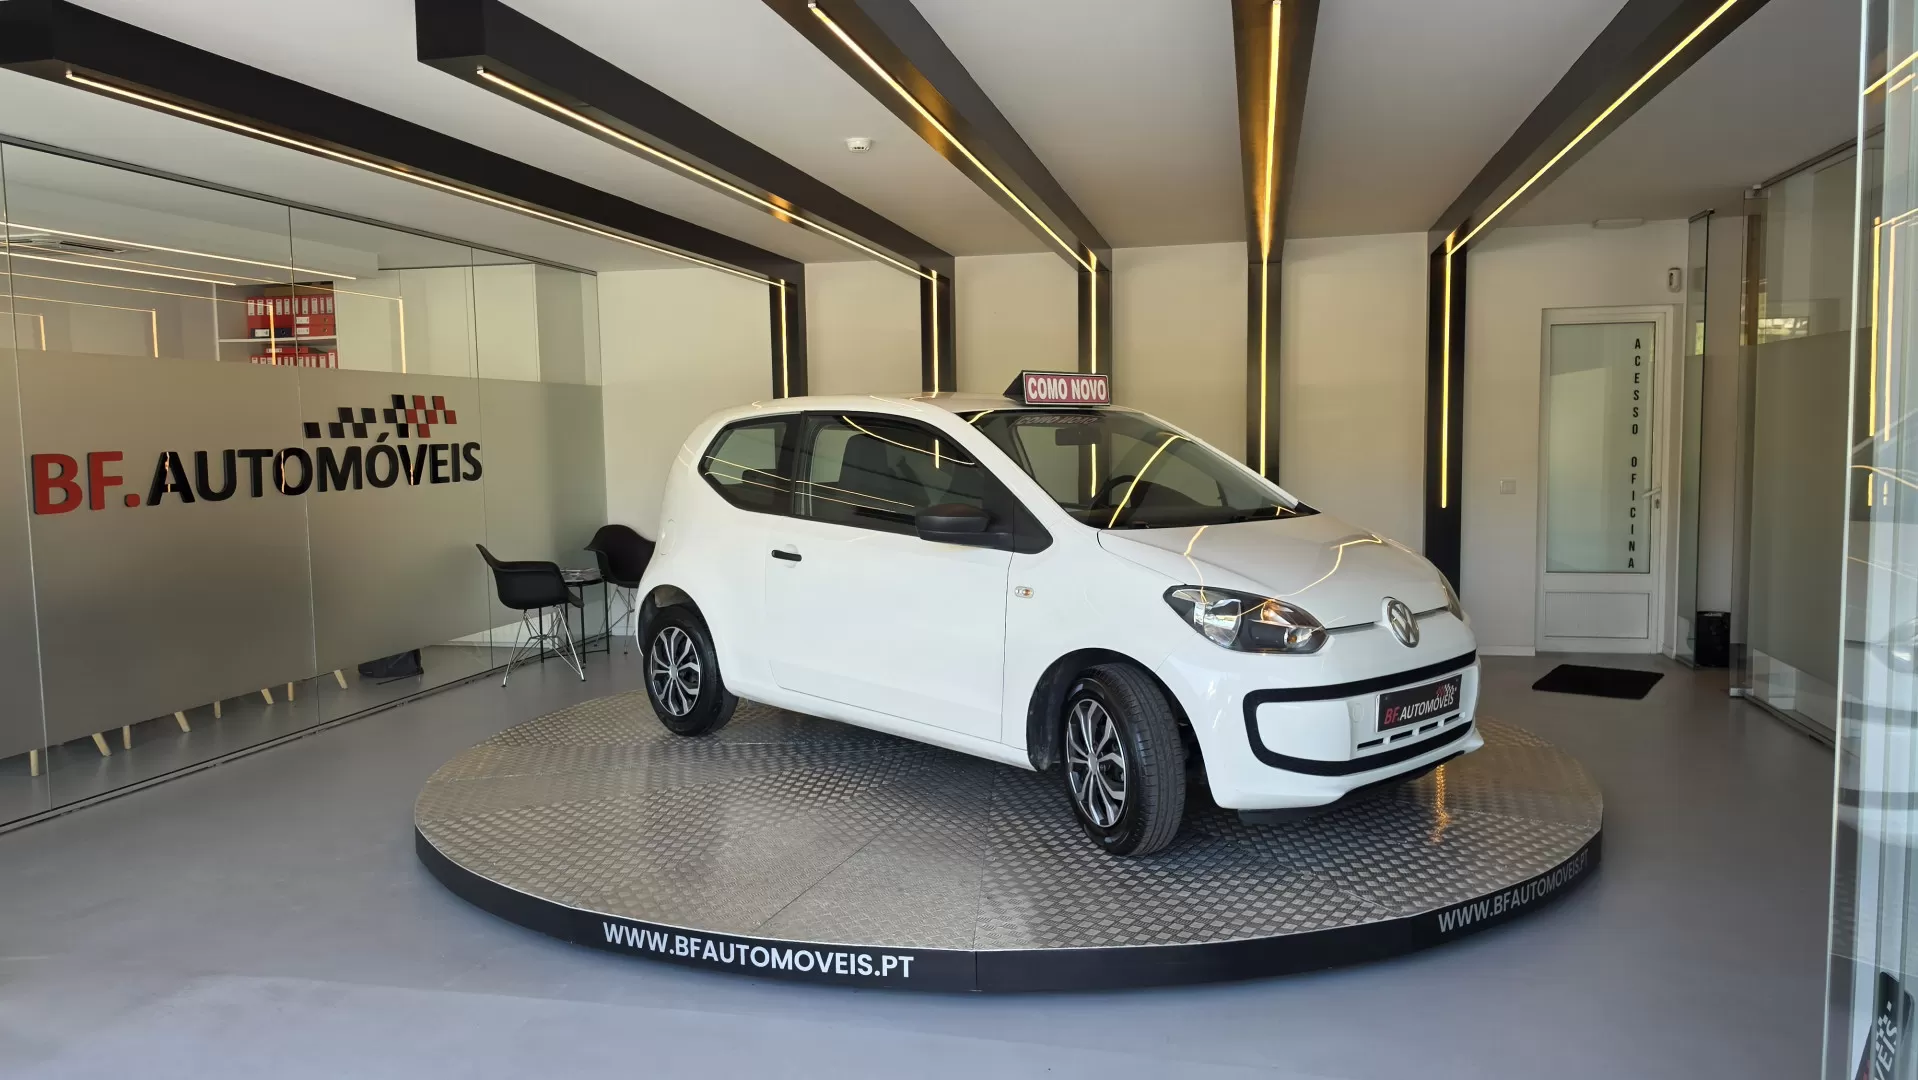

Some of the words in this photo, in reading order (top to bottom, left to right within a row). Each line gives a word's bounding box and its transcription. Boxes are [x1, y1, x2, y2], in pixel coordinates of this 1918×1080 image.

[1027, 377, 1068, 400] COMO
[1071, 379, 1107, 401] NOVO
[1631, 338, 1641, 435] ACESSO
[1628, 456, 1638, 569] OFICINA
[1438, 847, 1589, 933] WWW.BFAUTOMOVEIS.PT
[602, 921, 915, 978] WWW.BFAUTOMOVEIS.PT
